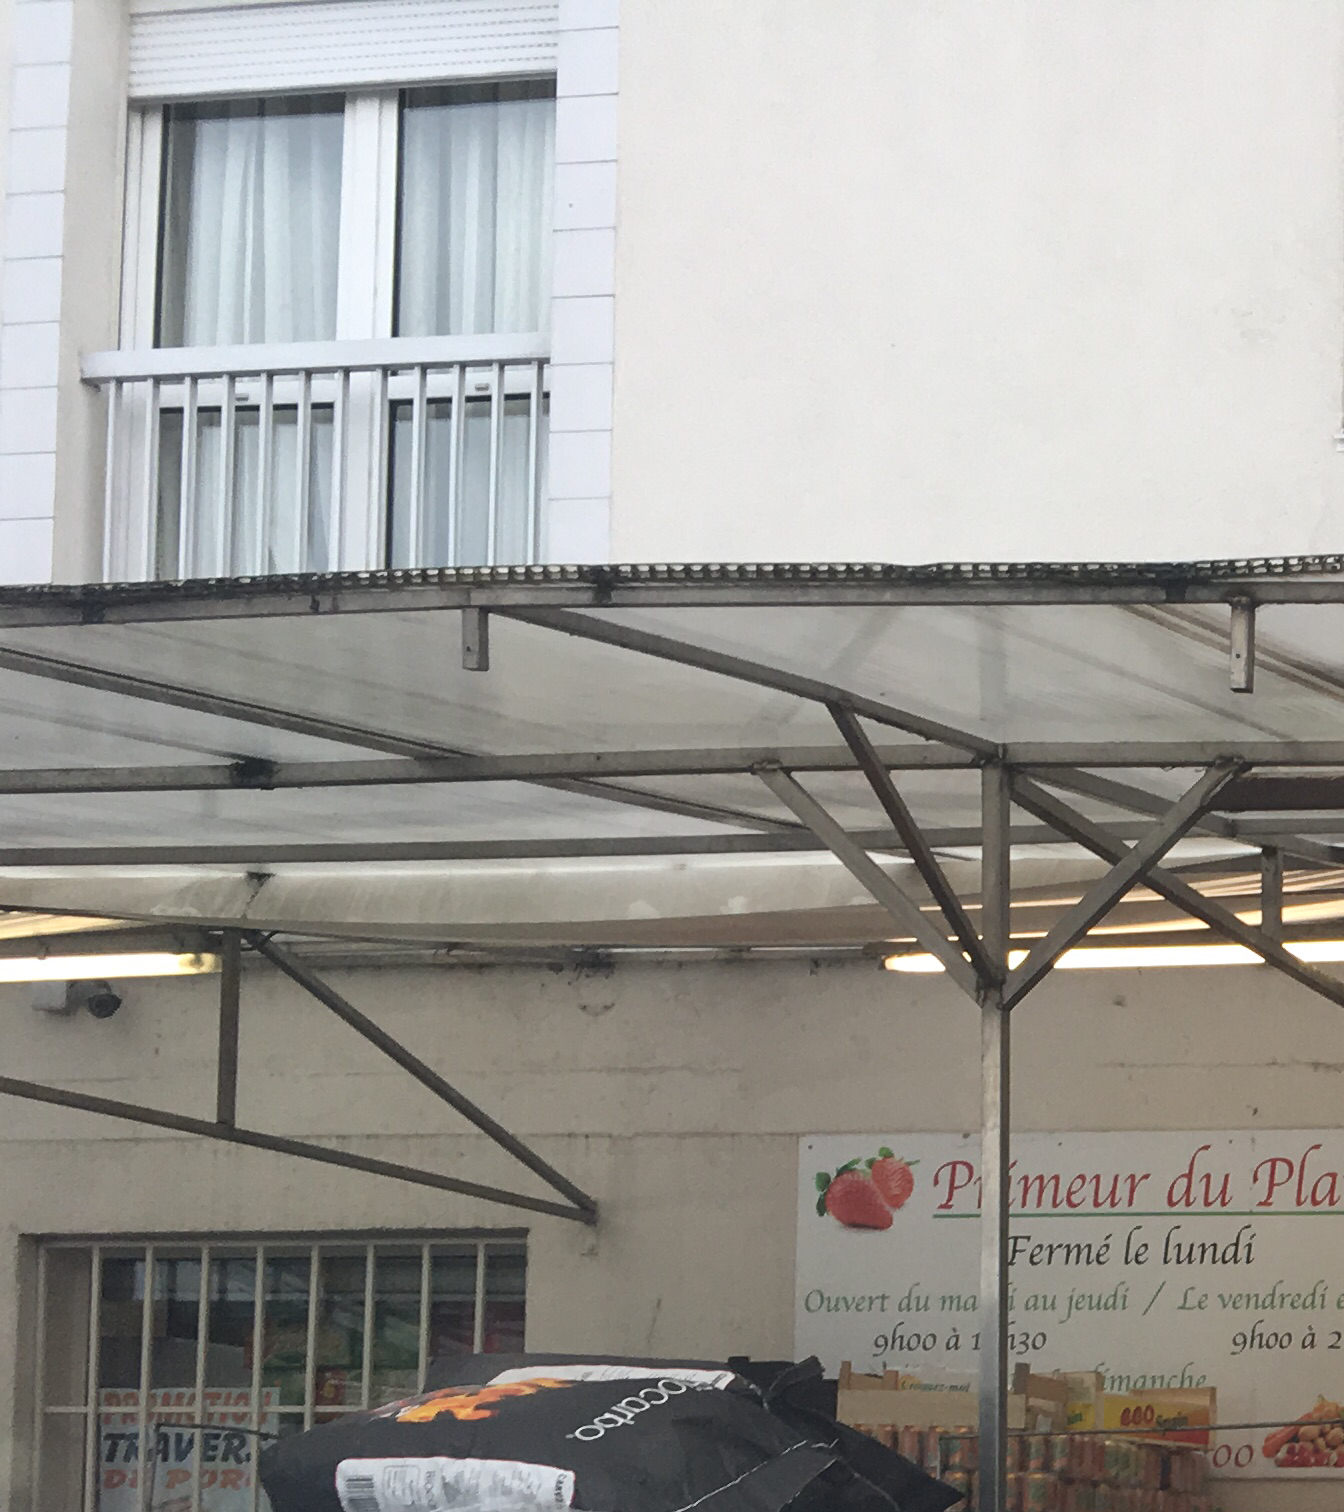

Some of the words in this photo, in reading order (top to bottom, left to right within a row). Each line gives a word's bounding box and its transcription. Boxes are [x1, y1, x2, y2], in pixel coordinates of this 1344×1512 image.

[1167, 1144, 1233, 1208] du
[1007, 1233, 1112, 1267] Fermé
[1123, 1225, 1149, 1265] le
[1162, 1224, 1256, 1265] lundi
[804, 1288, 890, 1314] Ouvert
[897, 1282, 931, 1313] du
[939, 1282, 1017, 1313] mai
[1023, 1293, 1057, 1312] au
[1058, 1281, 1130, 1325] jeudi
[1142, 1280, 1167, 1316] /
[1176, 1286, 1208, 1311] Le
[1217, 1279, 1329, 1311] vendredi
[872, 1321, 938, 1358] 9h00
[945, 1326, 962, 1351] à
[971, 1320, 1048, 1356] 1h30
[1230, 1318, 1293, 1356] 9h00
[1300, 1324, 1318, 1350] à
[165, 1468, 252, 1491] POR
